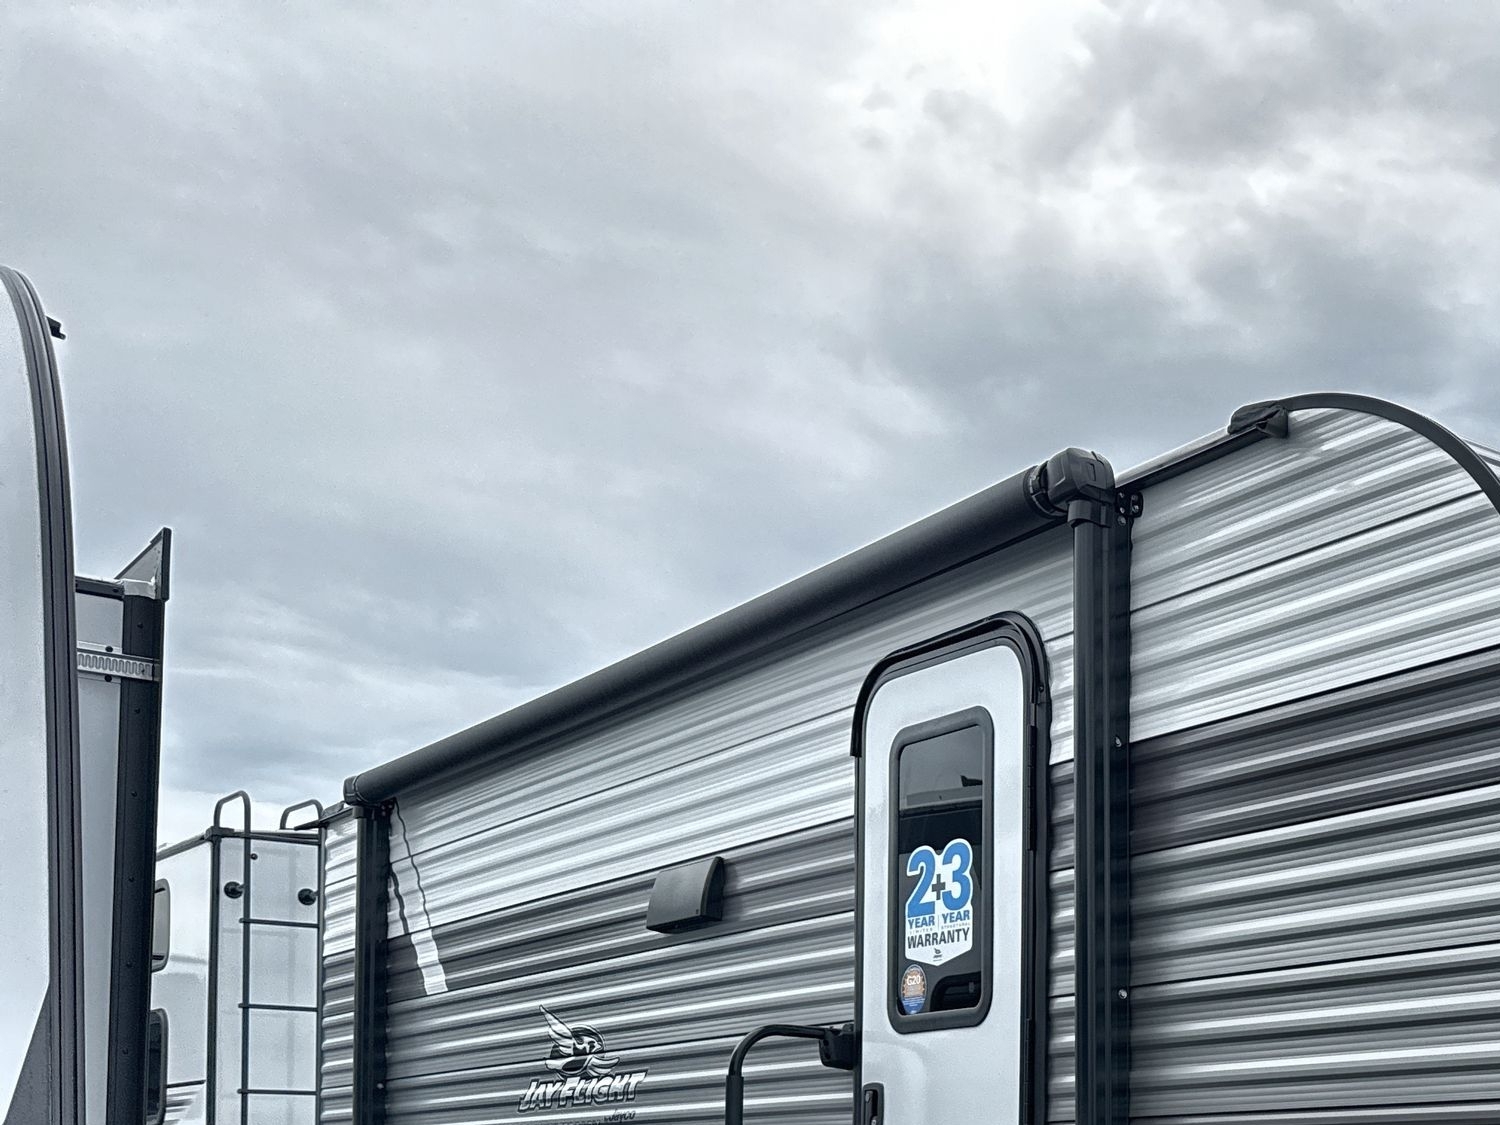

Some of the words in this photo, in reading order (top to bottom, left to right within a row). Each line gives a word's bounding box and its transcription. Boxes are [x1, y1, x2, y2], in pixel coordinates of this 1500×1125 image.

[908, 915, 935, 930] YEAR
[942, 909, 970, 924] YEAR
[907, 927, 970, 949] WARRANTY
